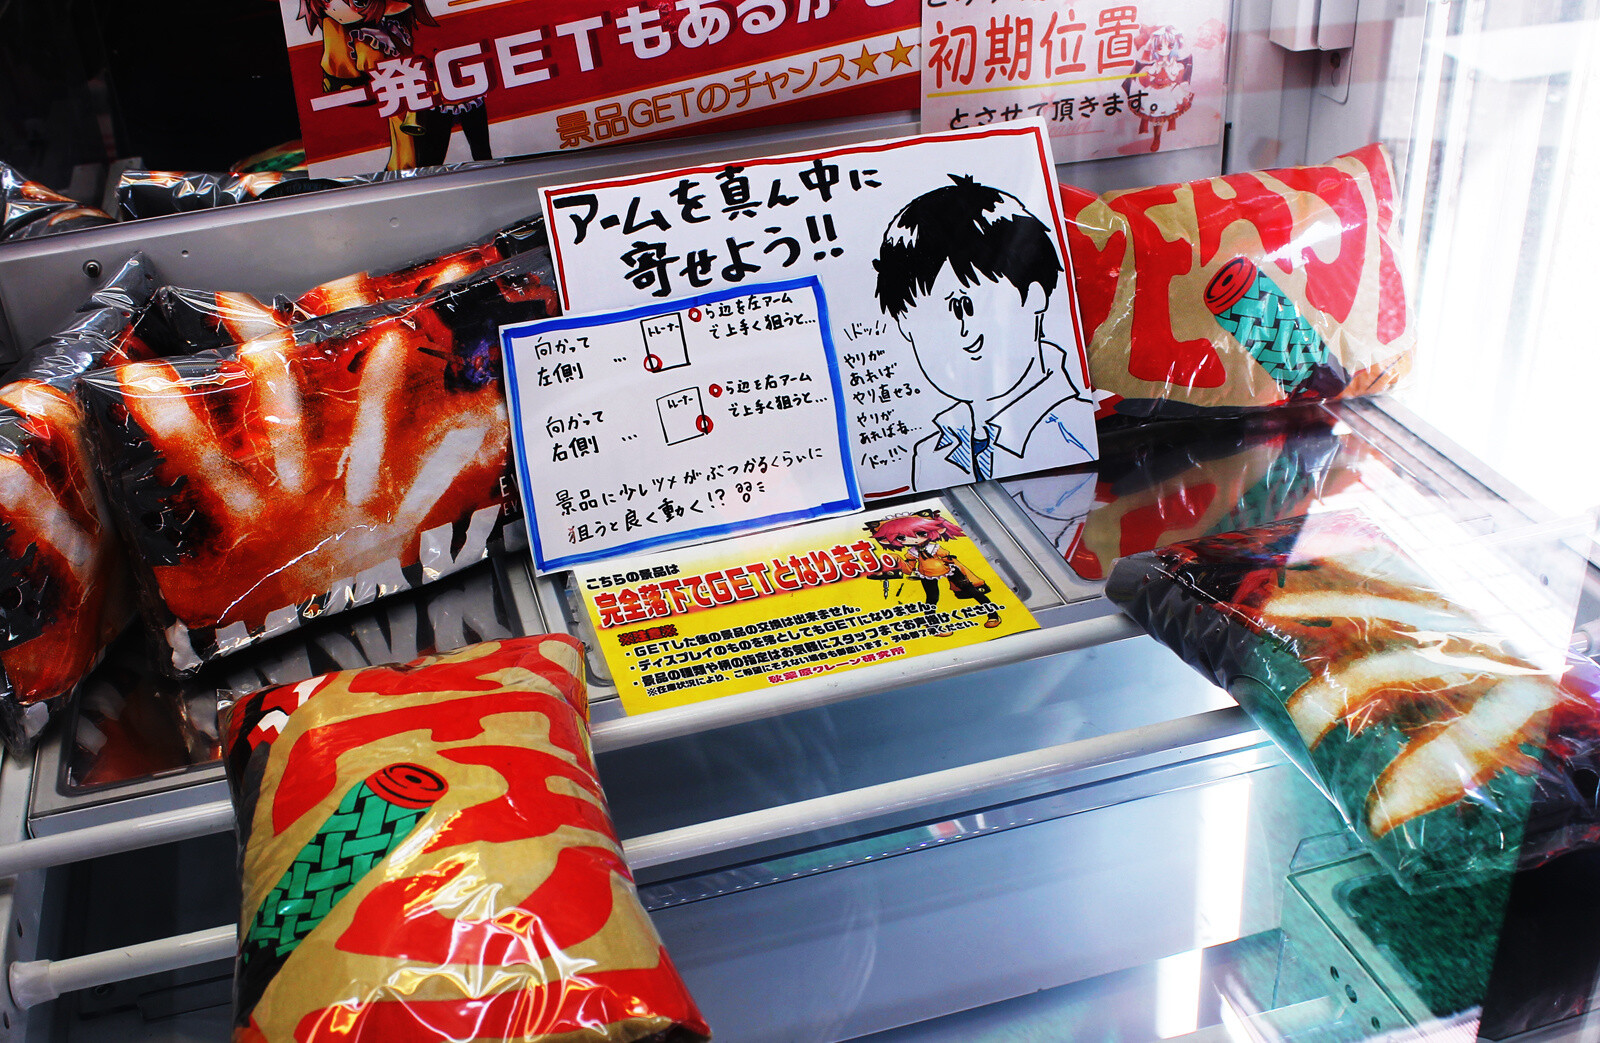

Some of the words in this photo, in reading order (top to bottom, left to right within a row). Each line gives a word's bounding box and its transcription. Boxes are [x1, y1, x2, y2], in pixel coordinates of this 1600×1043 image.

[928, 5, 1140, 89] 初期位置
[949, 89, 1159, 131] とさせて頂きます。
[553, 158, 883, 245] アームを真ん中に
[620, 213, 845, 297] 寄せよう!!
[534, 336, 590, 360] 向かって
[849, 362, 898, 387] あれば
[852, 383, 921, 405] やり直せる。
[545, 410, 604, 438] 向かって
[586, 563, 680, 590] こちらの景品は
[593, 540, 898, 628] 完全落下でGETとなります。
[768, 646, 906, 685] 秋葉原クレーン研究所
